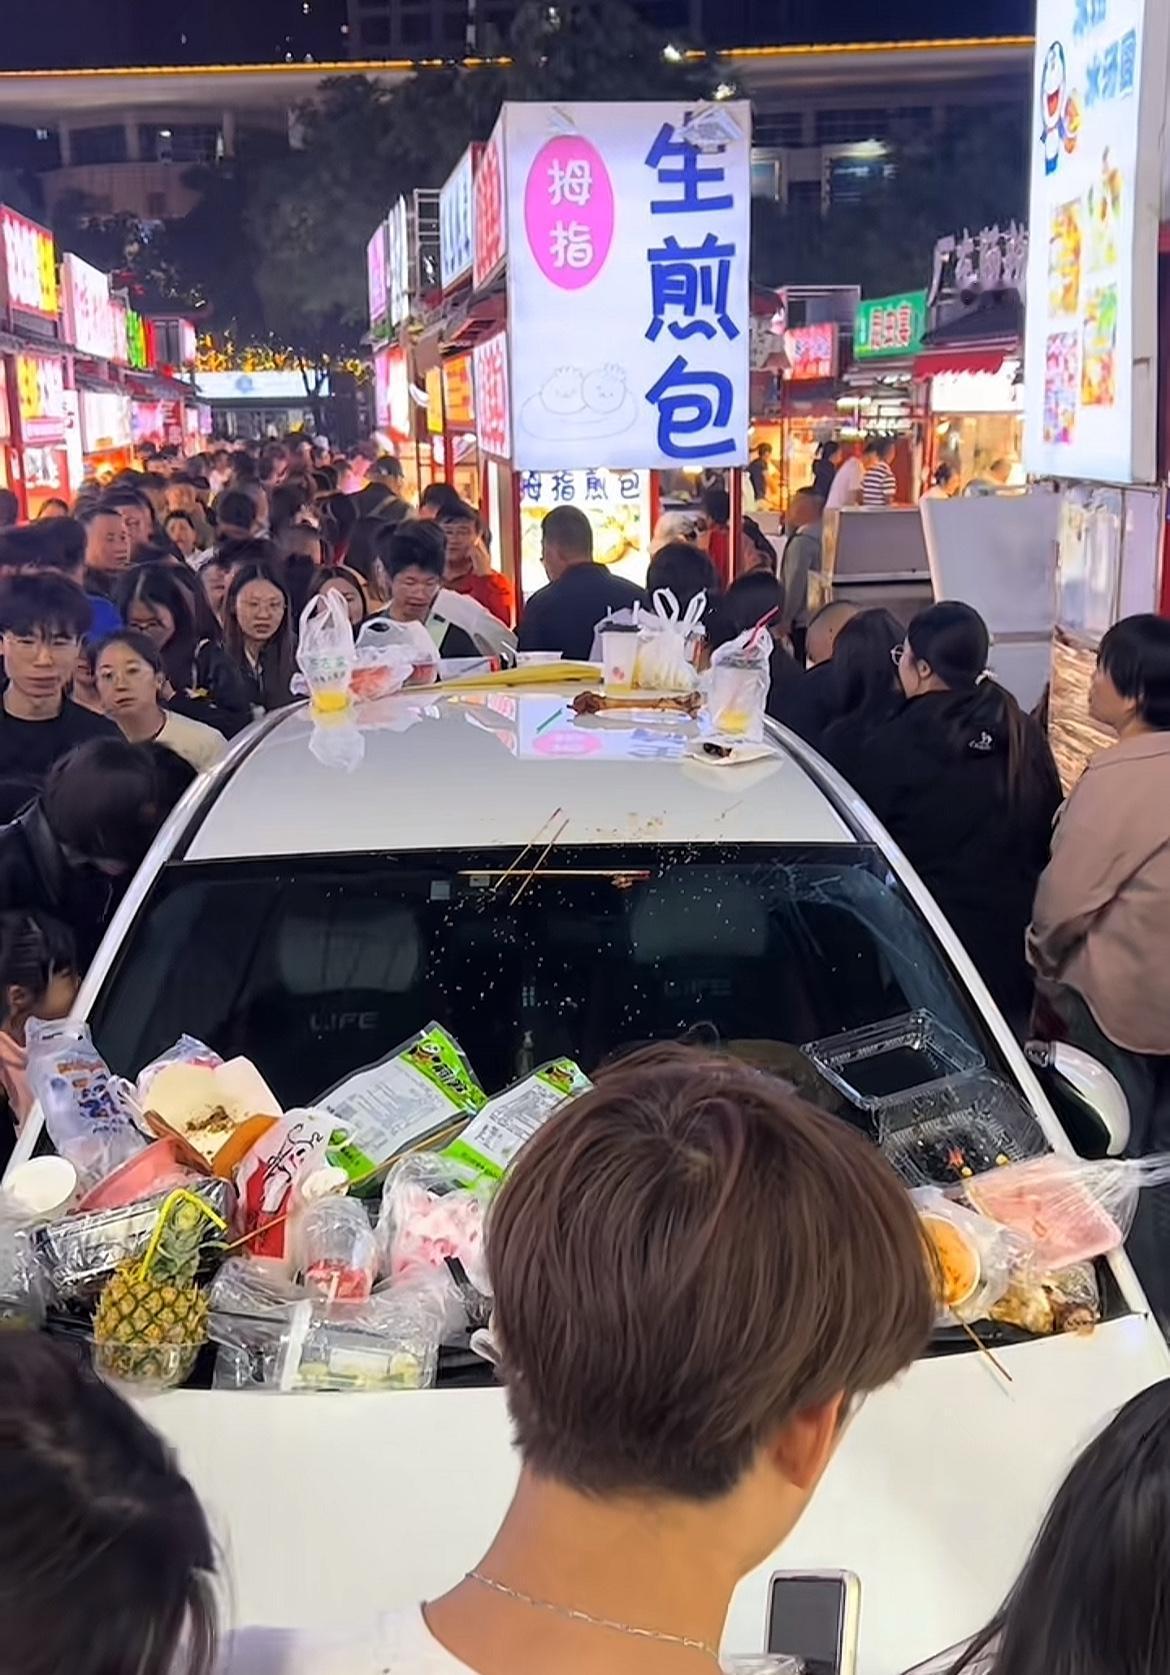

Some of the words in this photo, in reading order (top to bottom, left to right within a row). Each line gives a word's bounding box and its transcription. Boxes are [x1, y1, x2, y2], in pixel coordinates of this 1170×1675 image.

[547, 159, 593, 269] 拇指
[645, 111, 740, 460] 生煎包
[520, 469, 640, 501] 拇指煎包
